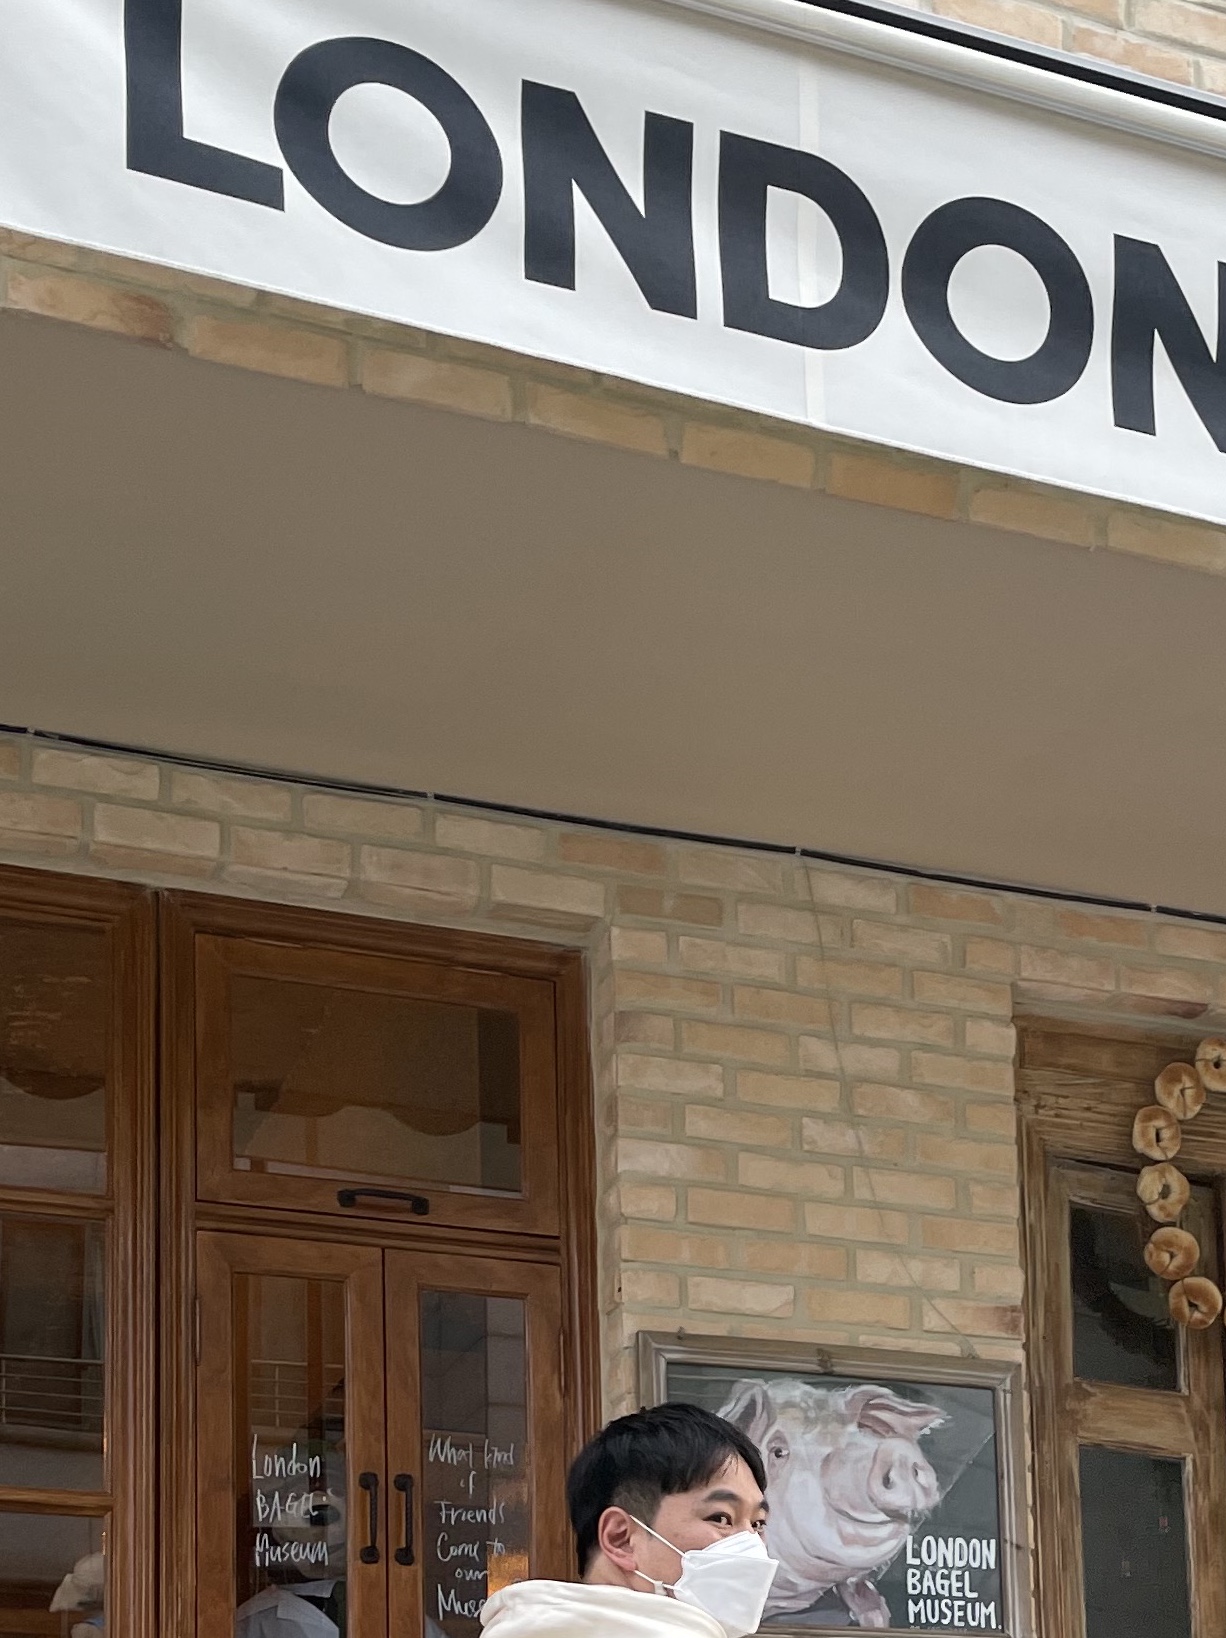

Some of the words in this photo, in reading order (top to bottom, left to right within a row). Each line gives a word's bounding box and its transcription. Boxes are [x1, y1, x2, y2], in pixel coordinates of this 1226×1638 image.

[252, 1433, 321, 1479] London
[428, 1434, 473, 1468] What
[434, 1498, 505, 1525] Friends
[255, 1532, 329, 1567] Museum
[906, 1535, 996, 1570] LONDON
[906, 1569, 978, 1598] BAGEL
[908, 1598, 1002, 1630] MUSEUM.
